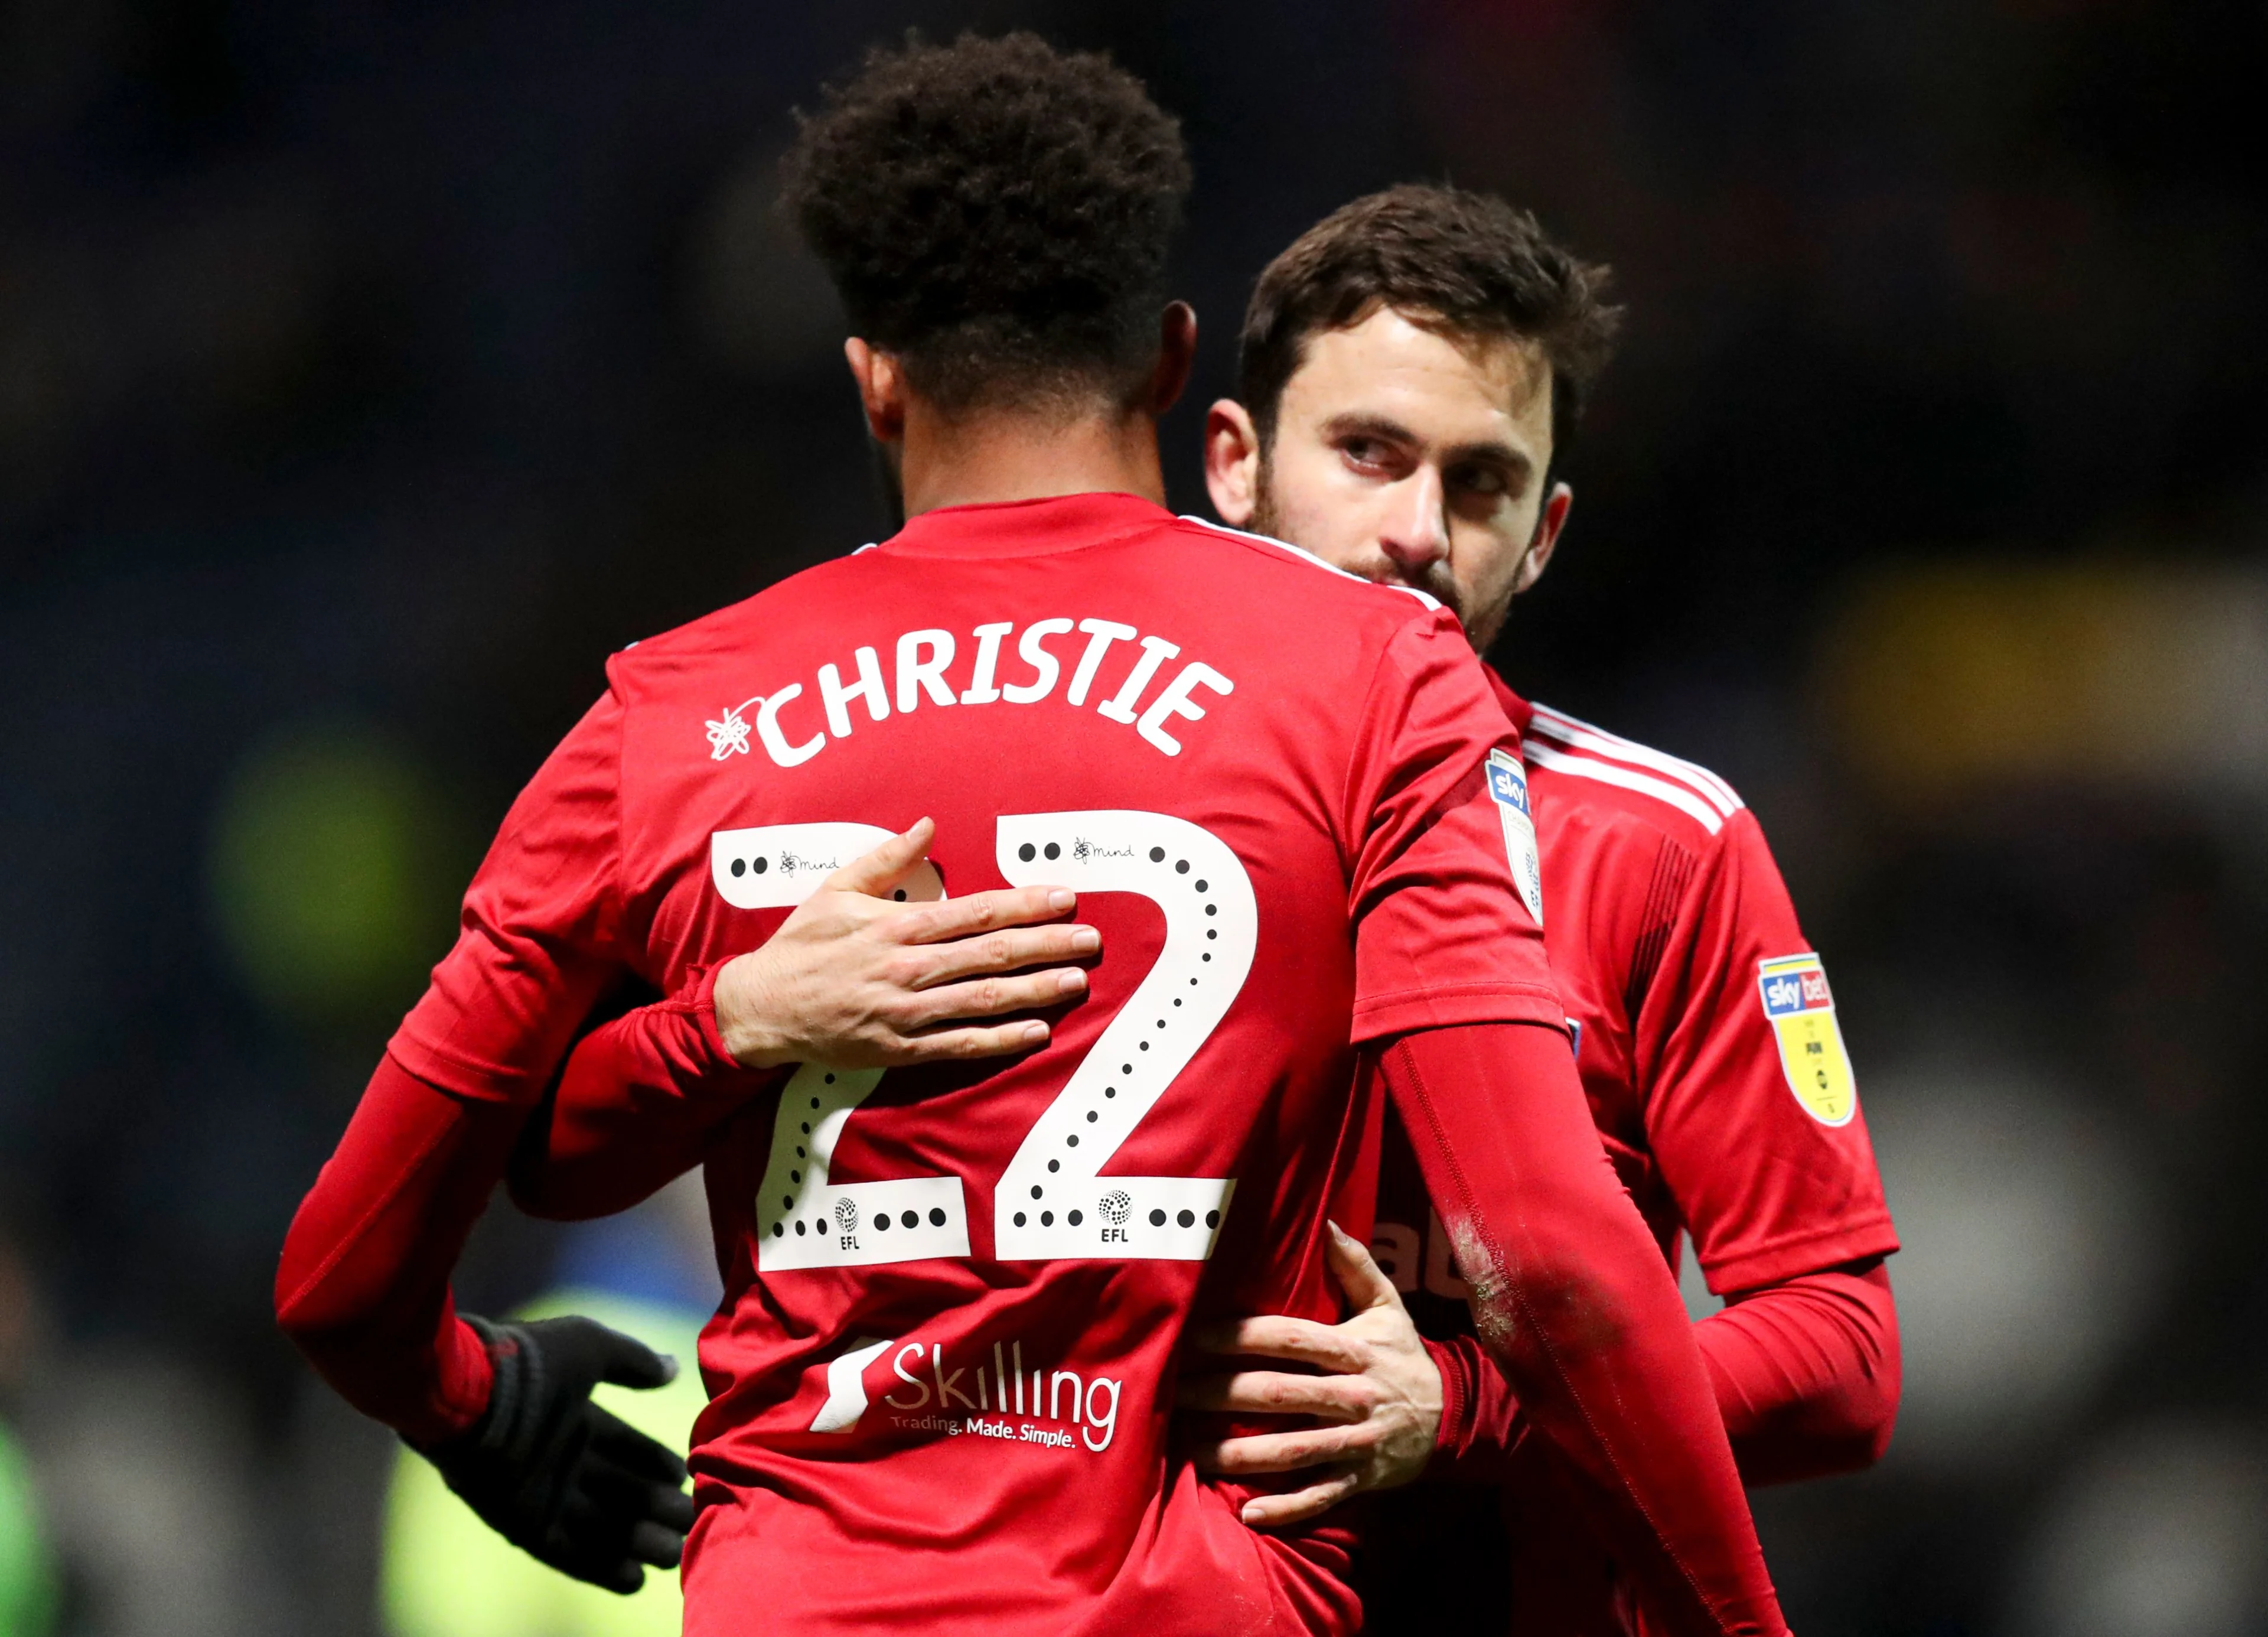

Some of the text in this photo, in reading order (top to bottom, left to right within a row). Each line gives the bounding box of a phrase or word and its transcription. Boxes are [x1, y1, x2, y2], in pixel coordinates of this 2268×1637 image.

[756, 617, 1233, 767] CHRISTIE
[1495, 773, 1524, 808] sky
[800, 857, 840, 871] mind
[1094, 845, 1135, 858] mind
[1767, 975, 1827, 1009] sky bet
[711, 809, 1258, 1271] 22
[840, 1236, 859, 1250] EFL
[1102, 1229, 1129, 1242] EFL
[885, 1340, 1122, 1452] Skilling
[891, 1416, 1076, 1449] Trading. Made. Simple.
